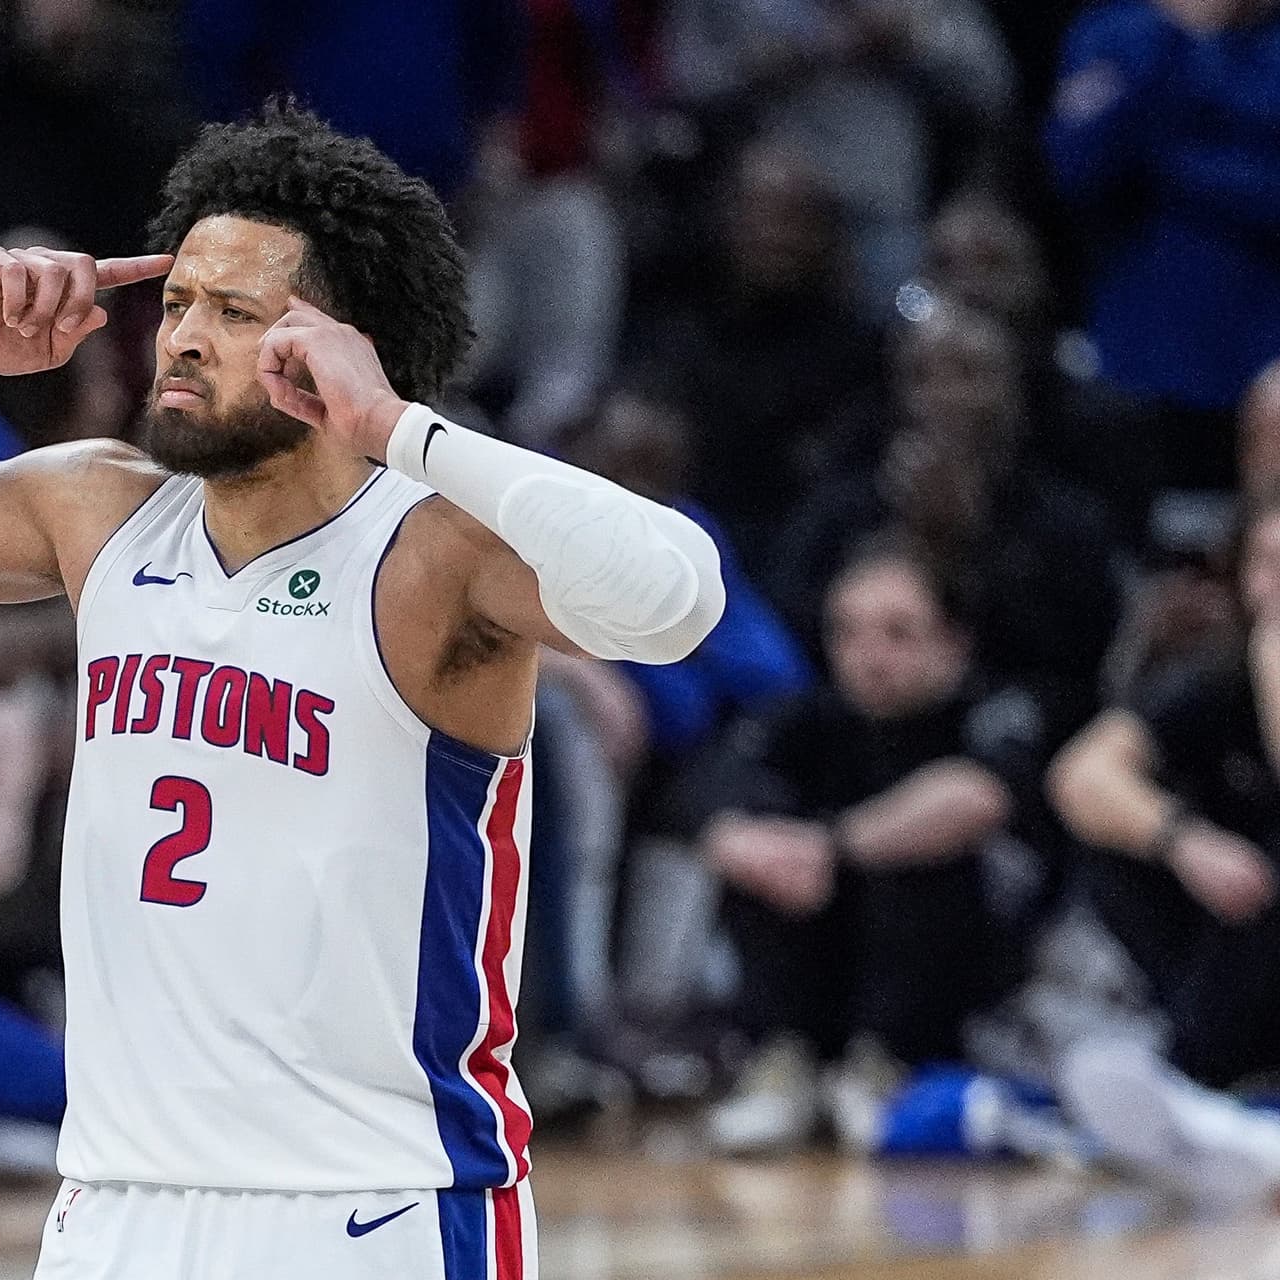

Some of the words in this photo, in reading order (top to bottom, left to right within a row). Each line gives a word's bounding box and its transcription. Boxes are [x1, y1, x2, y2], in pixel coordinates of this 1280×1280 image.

[256, 597, 331, 617] StockX
[84, 653, 336, 777] PISTONS
[139, 775, 213, 908] 2
